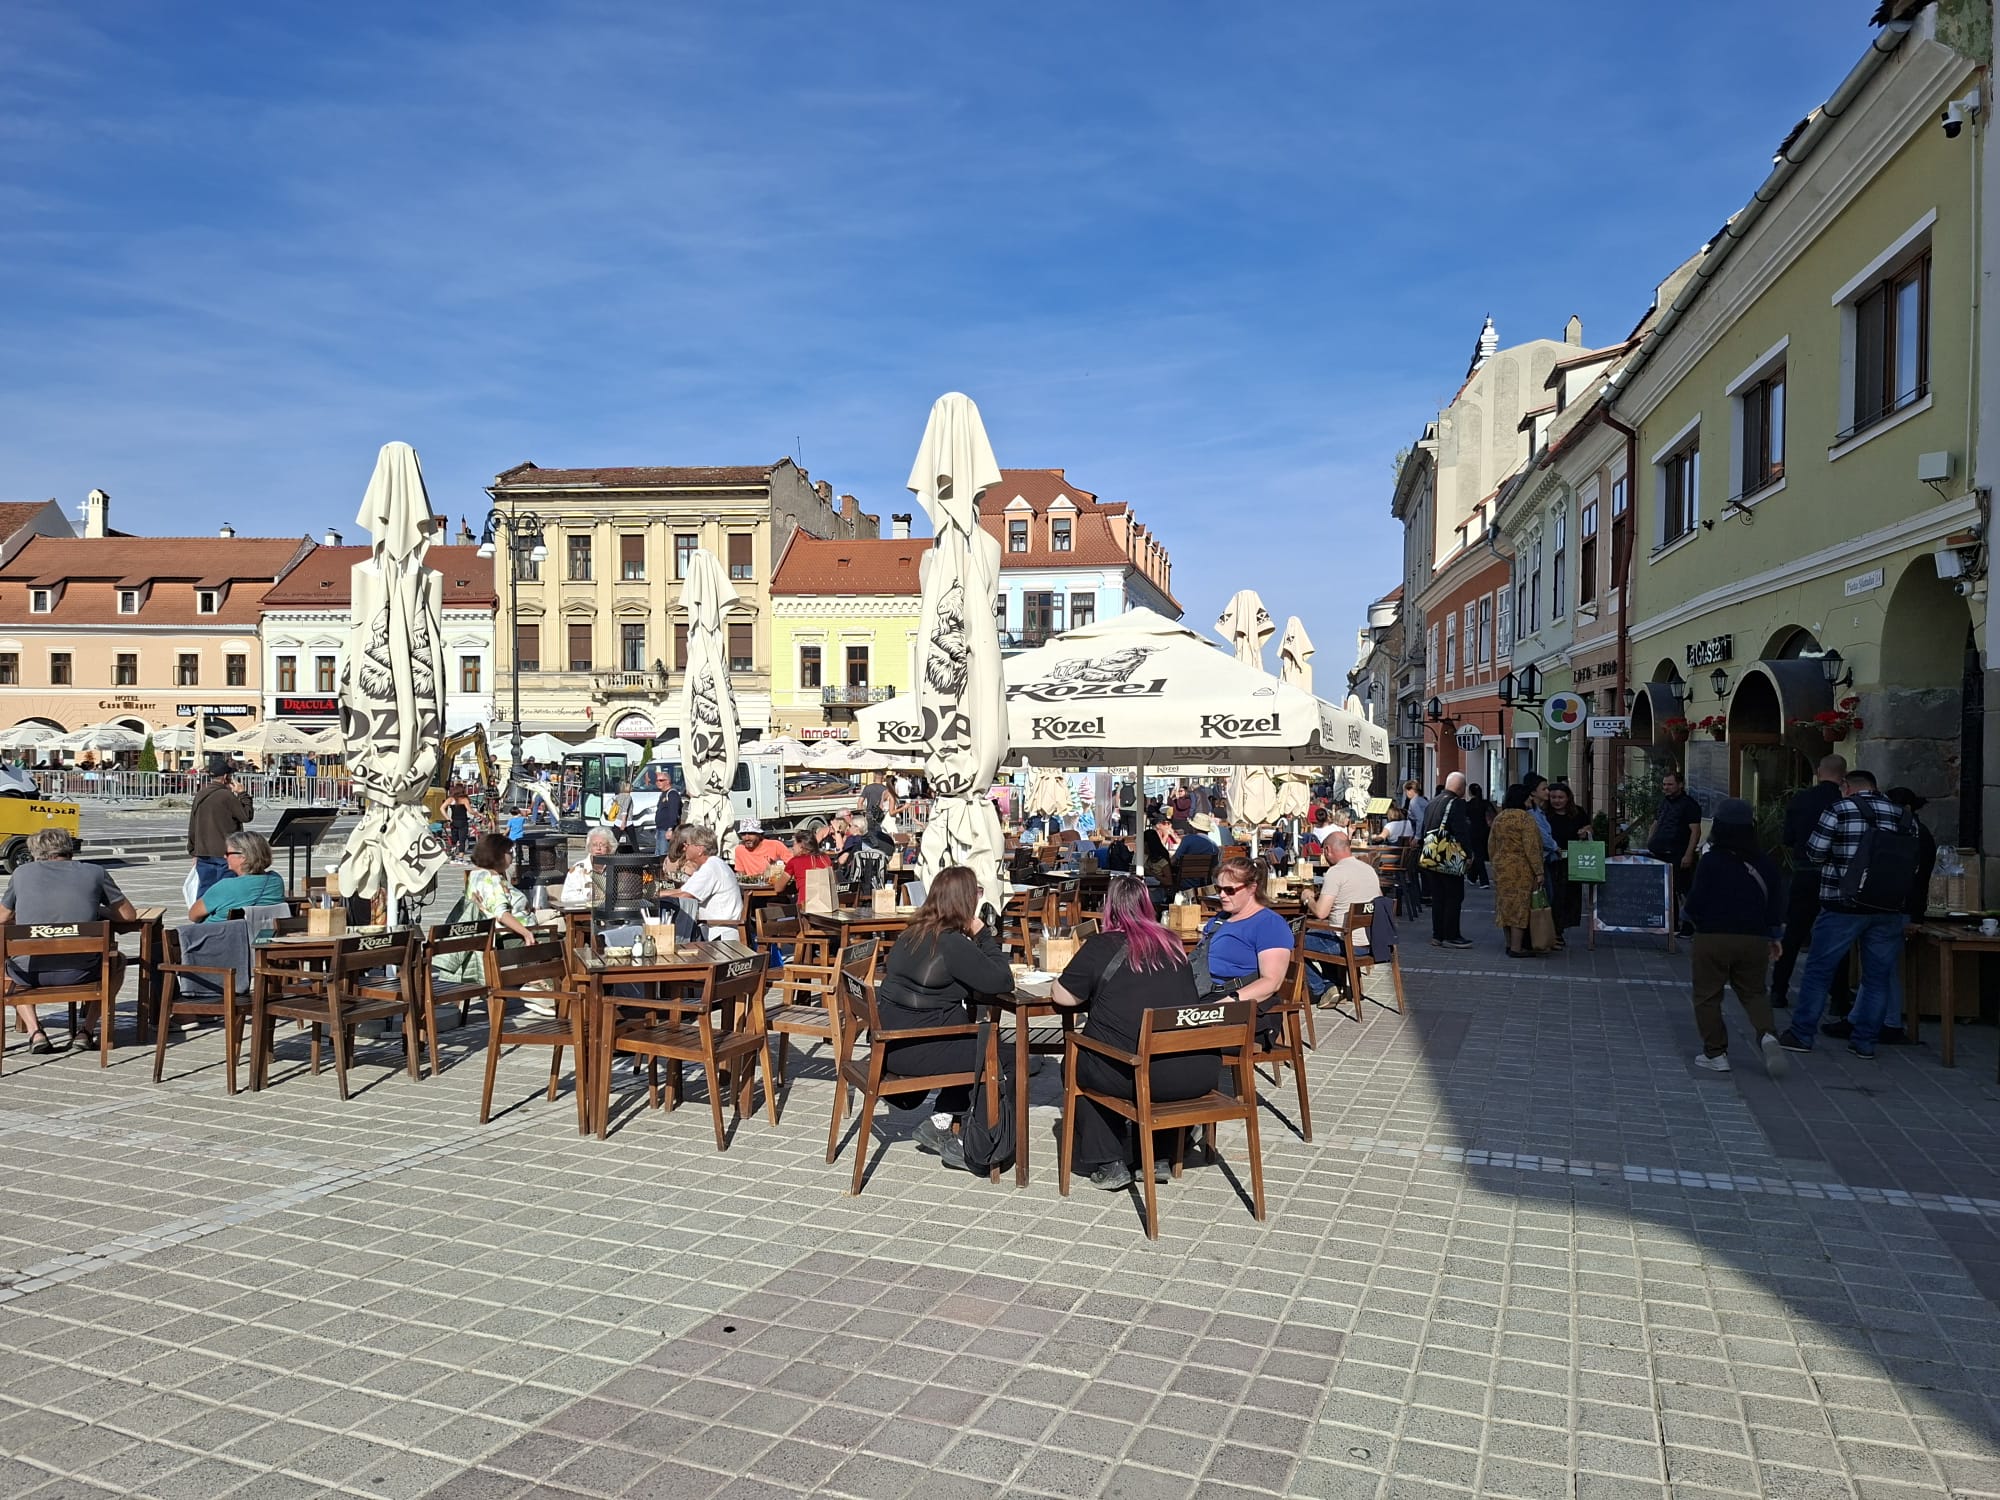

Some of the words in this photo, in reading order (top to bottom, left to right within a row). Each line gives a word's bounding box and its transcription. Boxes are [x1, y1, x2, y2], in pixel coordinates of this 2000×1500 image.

[219, 706, 246, 714] TOBACCO
[283, 699, 336, 711] DRACULA
[876, 721, 923, 744] Koz
[1031, 716, 1106, 740] Kozel
[1200, 713, 1281, 740] Kozel
[30, 924, 80, 938] Kozel
[449, 922, 478, 937] Kozel
[358, 934, 393, 951] Kozel
[726, 959, 754, 977] Kozel
[1175, 1006, 1226, 1027] Kozel
